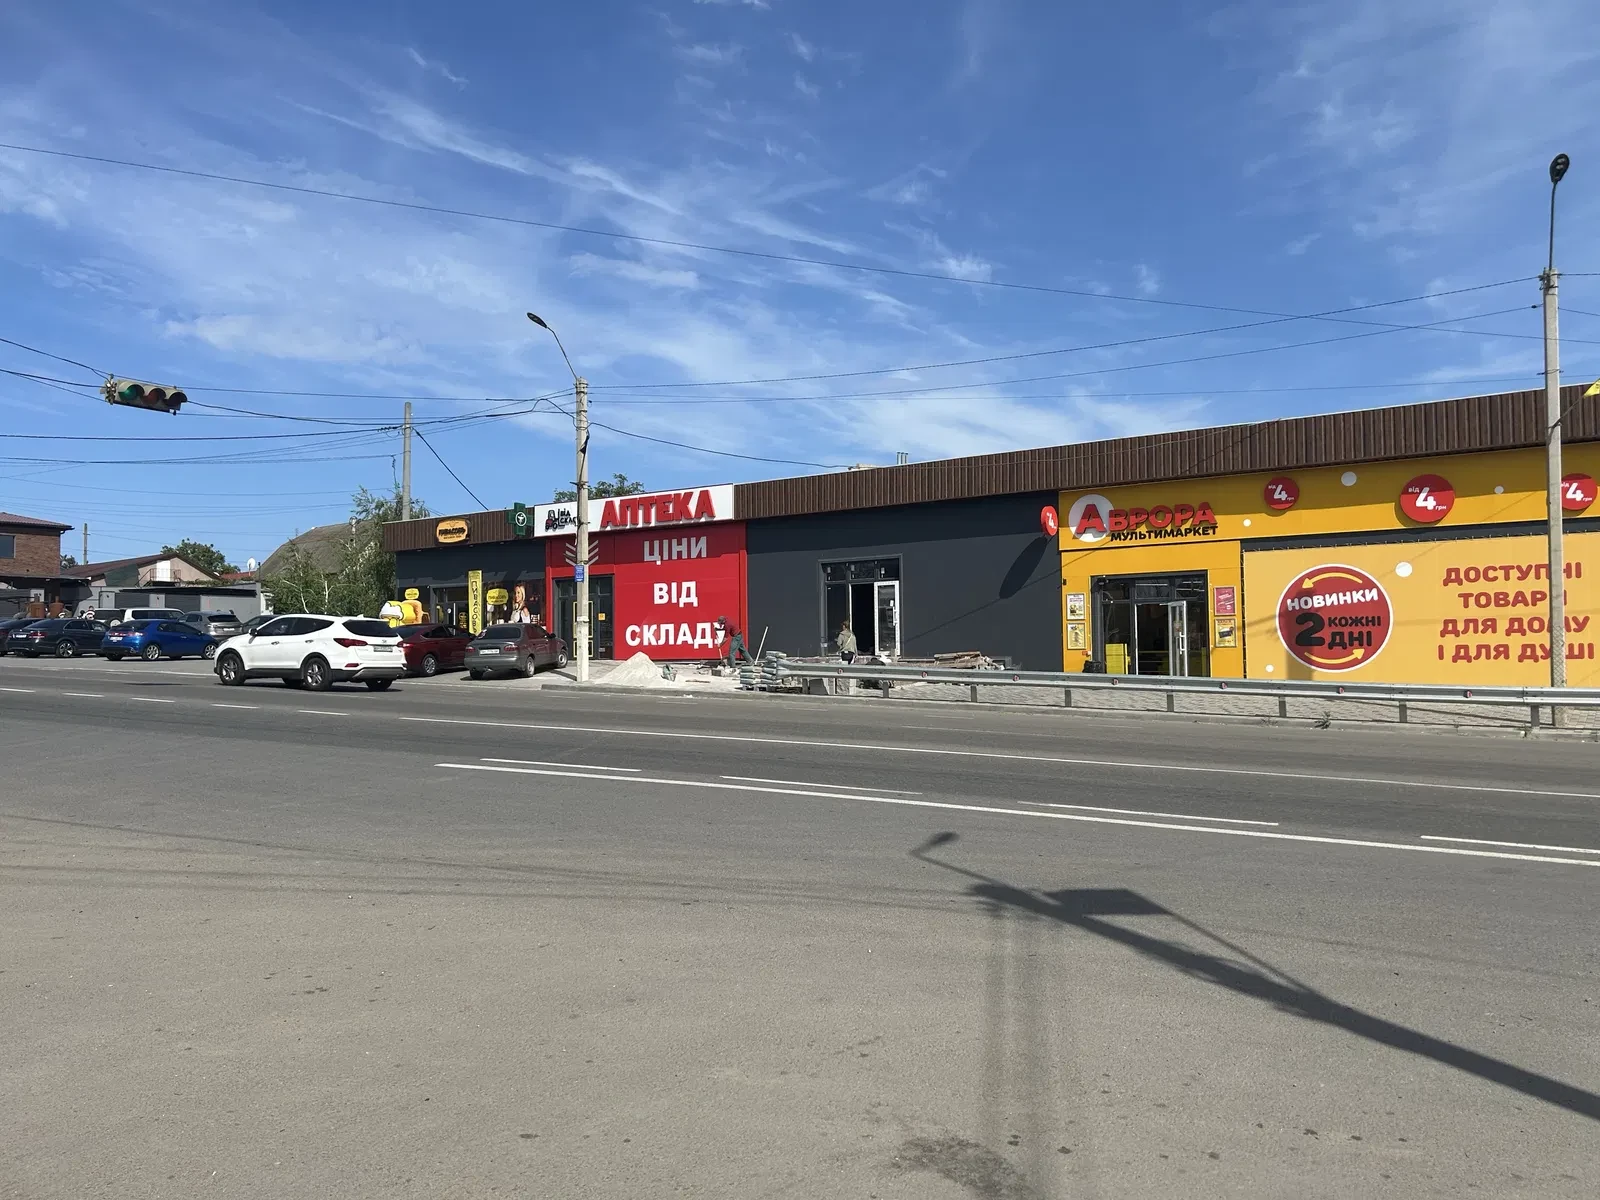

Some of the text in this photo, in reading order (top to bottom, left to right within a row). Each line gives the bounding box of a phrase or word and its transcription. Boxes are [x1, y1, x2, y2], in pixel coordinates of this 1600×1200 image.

[1273, 484, 1288, 500] 4
[1415, 487, 1437, 510] 4
[1566, 482, 1584, 501] 4
[600, 489, 717, 529] АПТЕКА
[1110, 525, 1218, 542] МУЛЬТИМАРКЕТ
[643, 535, 707, 565] ЦІНИ
[653, 580, 699, 608] ВІД
[1286, 587, 1379, 611] НОВИНКИ
[1457, 590, 1567, 609] ТОВАР
[1295, 612, 1382, 647] 2 КОЖНІ
[1440, 617, 1498, 638] ДЛЯ
[1327, 630, 1372, 650] ДНІ
[1437, 644, 1445, 661] І
[1451, 644, 1510, 664] ДЛЯ
